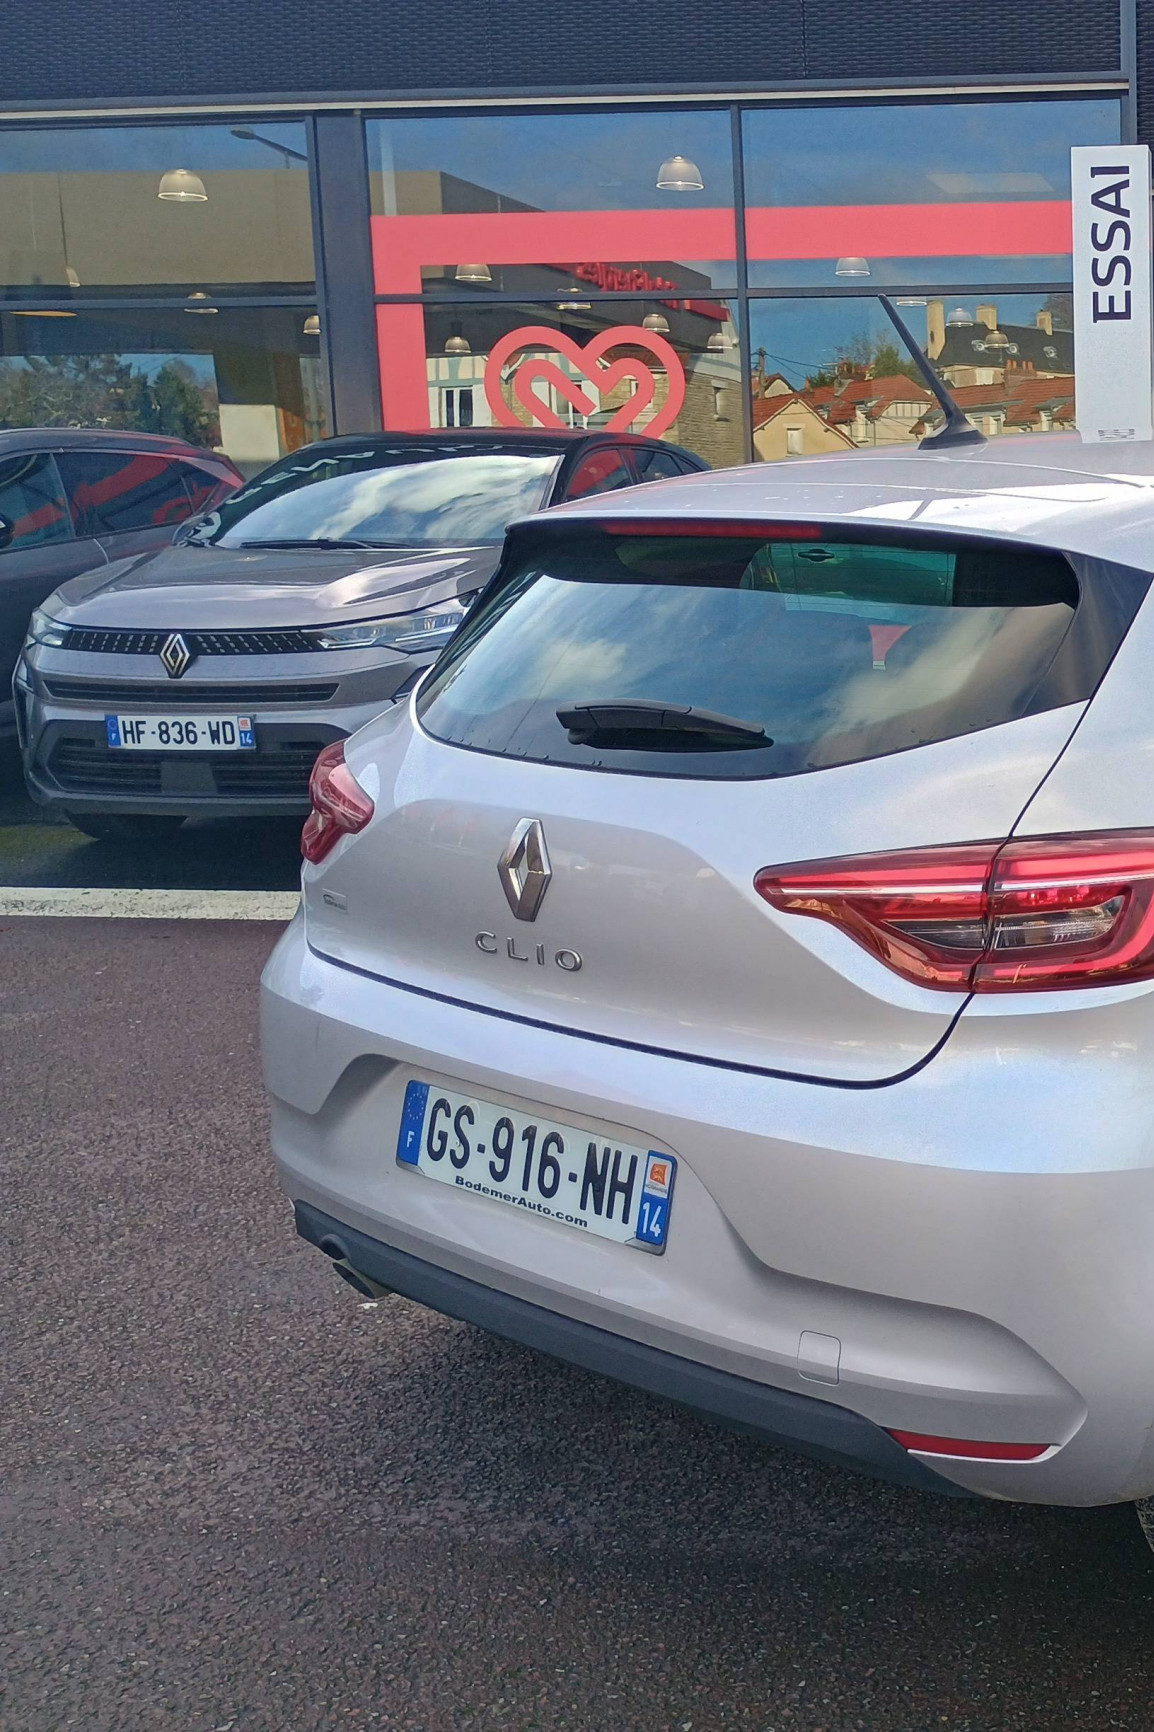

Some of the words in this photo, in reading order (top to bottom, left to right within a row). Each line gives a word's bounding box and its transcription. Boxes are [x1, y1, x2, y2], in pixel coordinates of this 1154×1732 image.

[1090, 166, 1131, 323] ESSAI
[122, 720, 235, 744] HF-836-WD
[240, 733, 252, 744] 14
[475, 930, 583, 972] CLIO
[406, 1130, 415, 1148] F
[427, 1098, 638, 1225] GS-916-NH
[455, 1175, 588, 1228] BodemerAuto.com
[642, 1202, 662, 1238] 14
